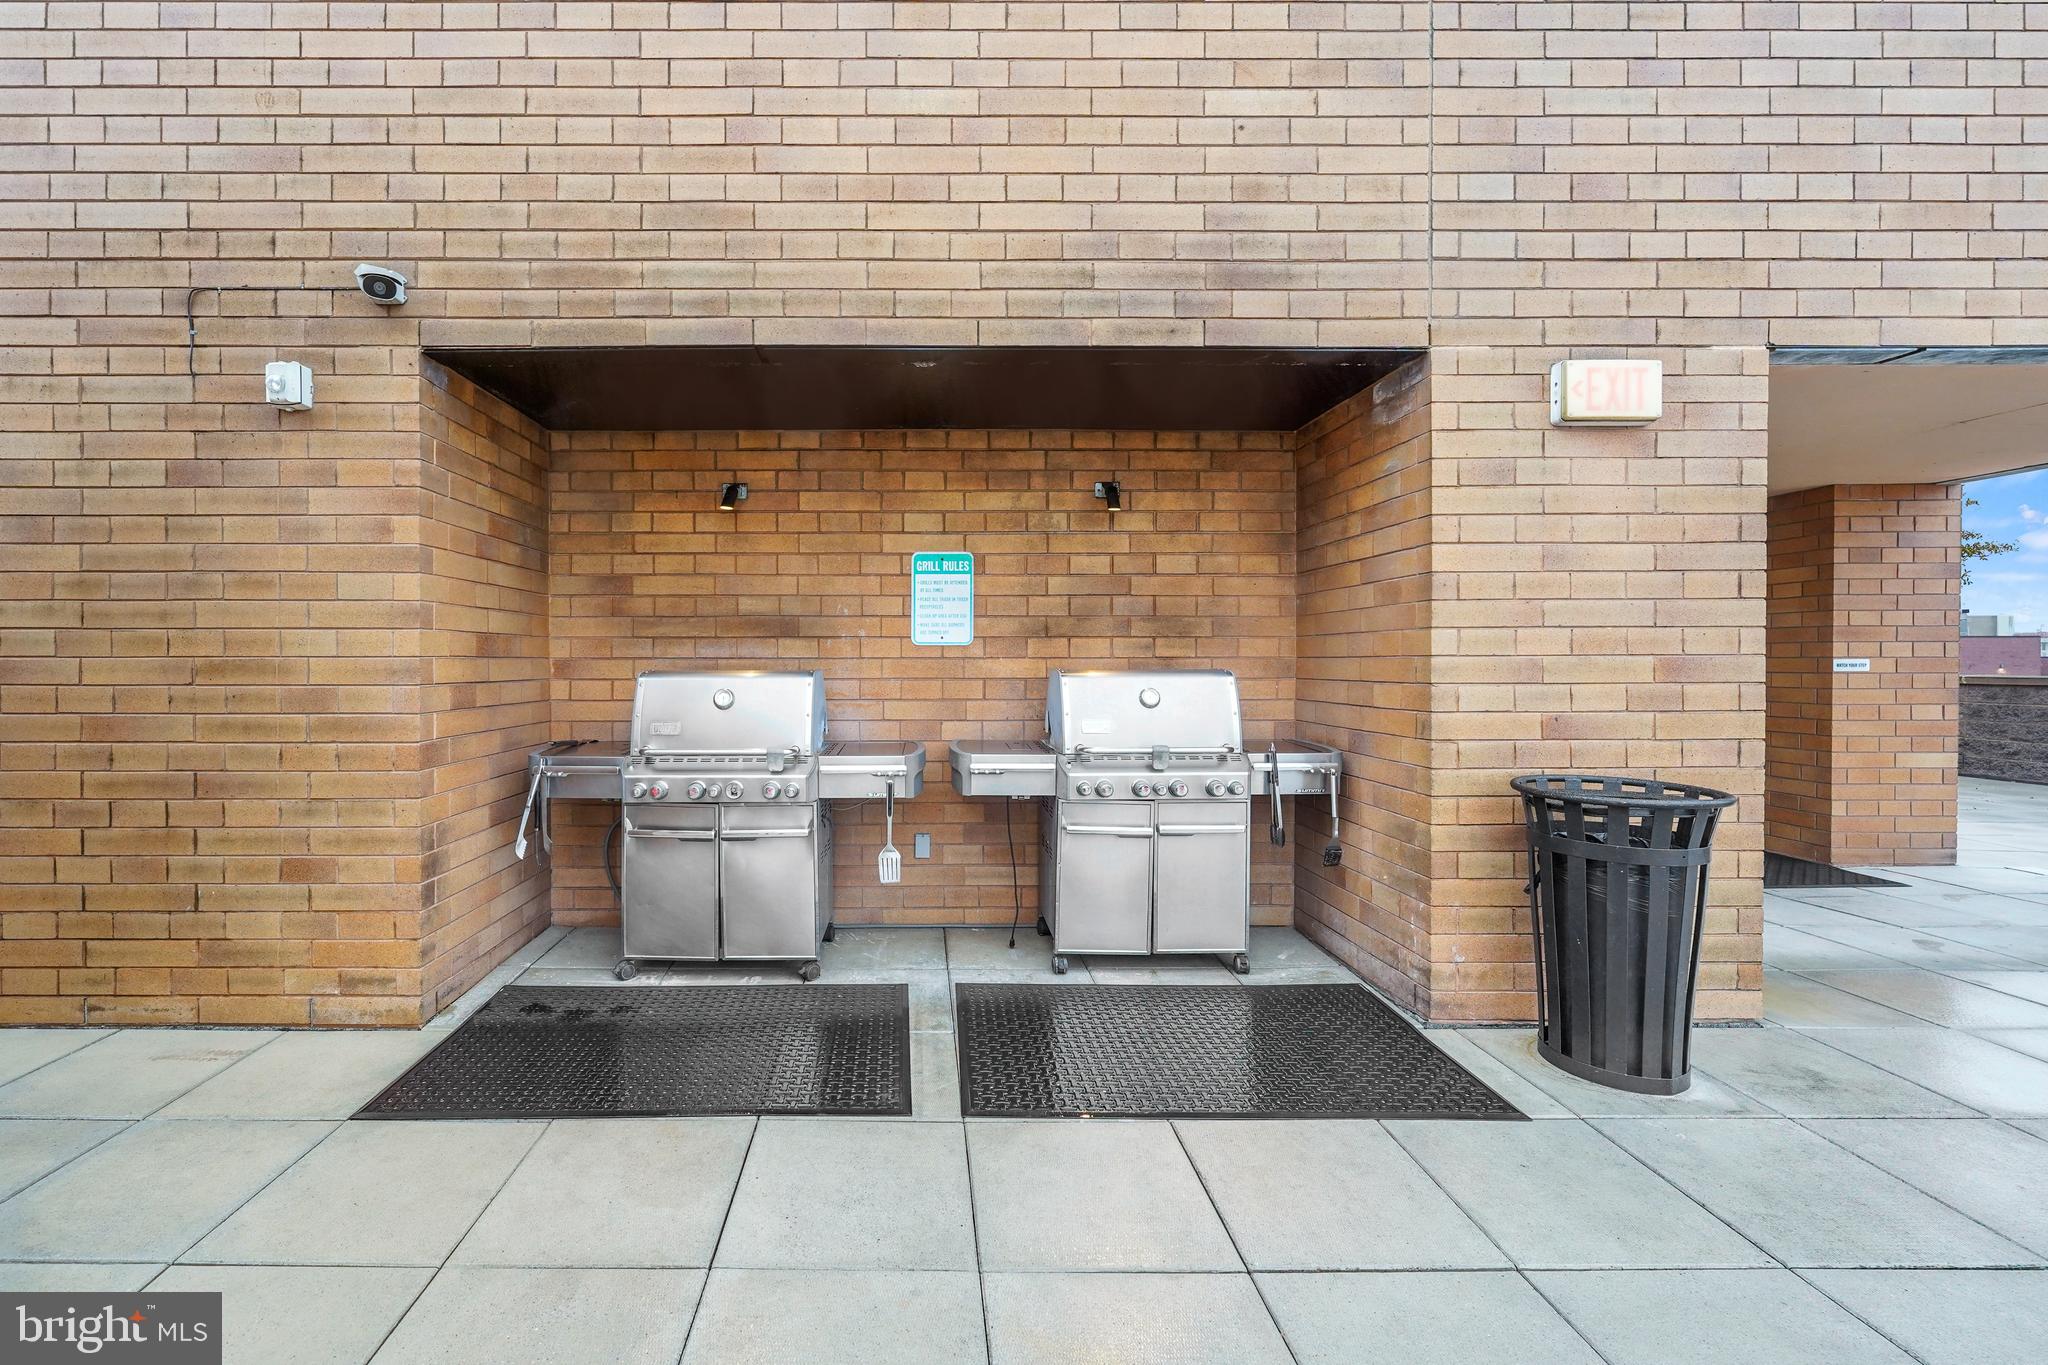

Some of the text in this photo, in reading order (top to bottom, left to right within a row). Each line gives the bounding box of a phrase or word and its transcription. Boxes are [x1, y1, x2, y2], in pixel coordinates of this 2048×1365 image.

[1586, 367, 1648, 411] EXIT
[917, 560, 969, 571] GRILL RULES
